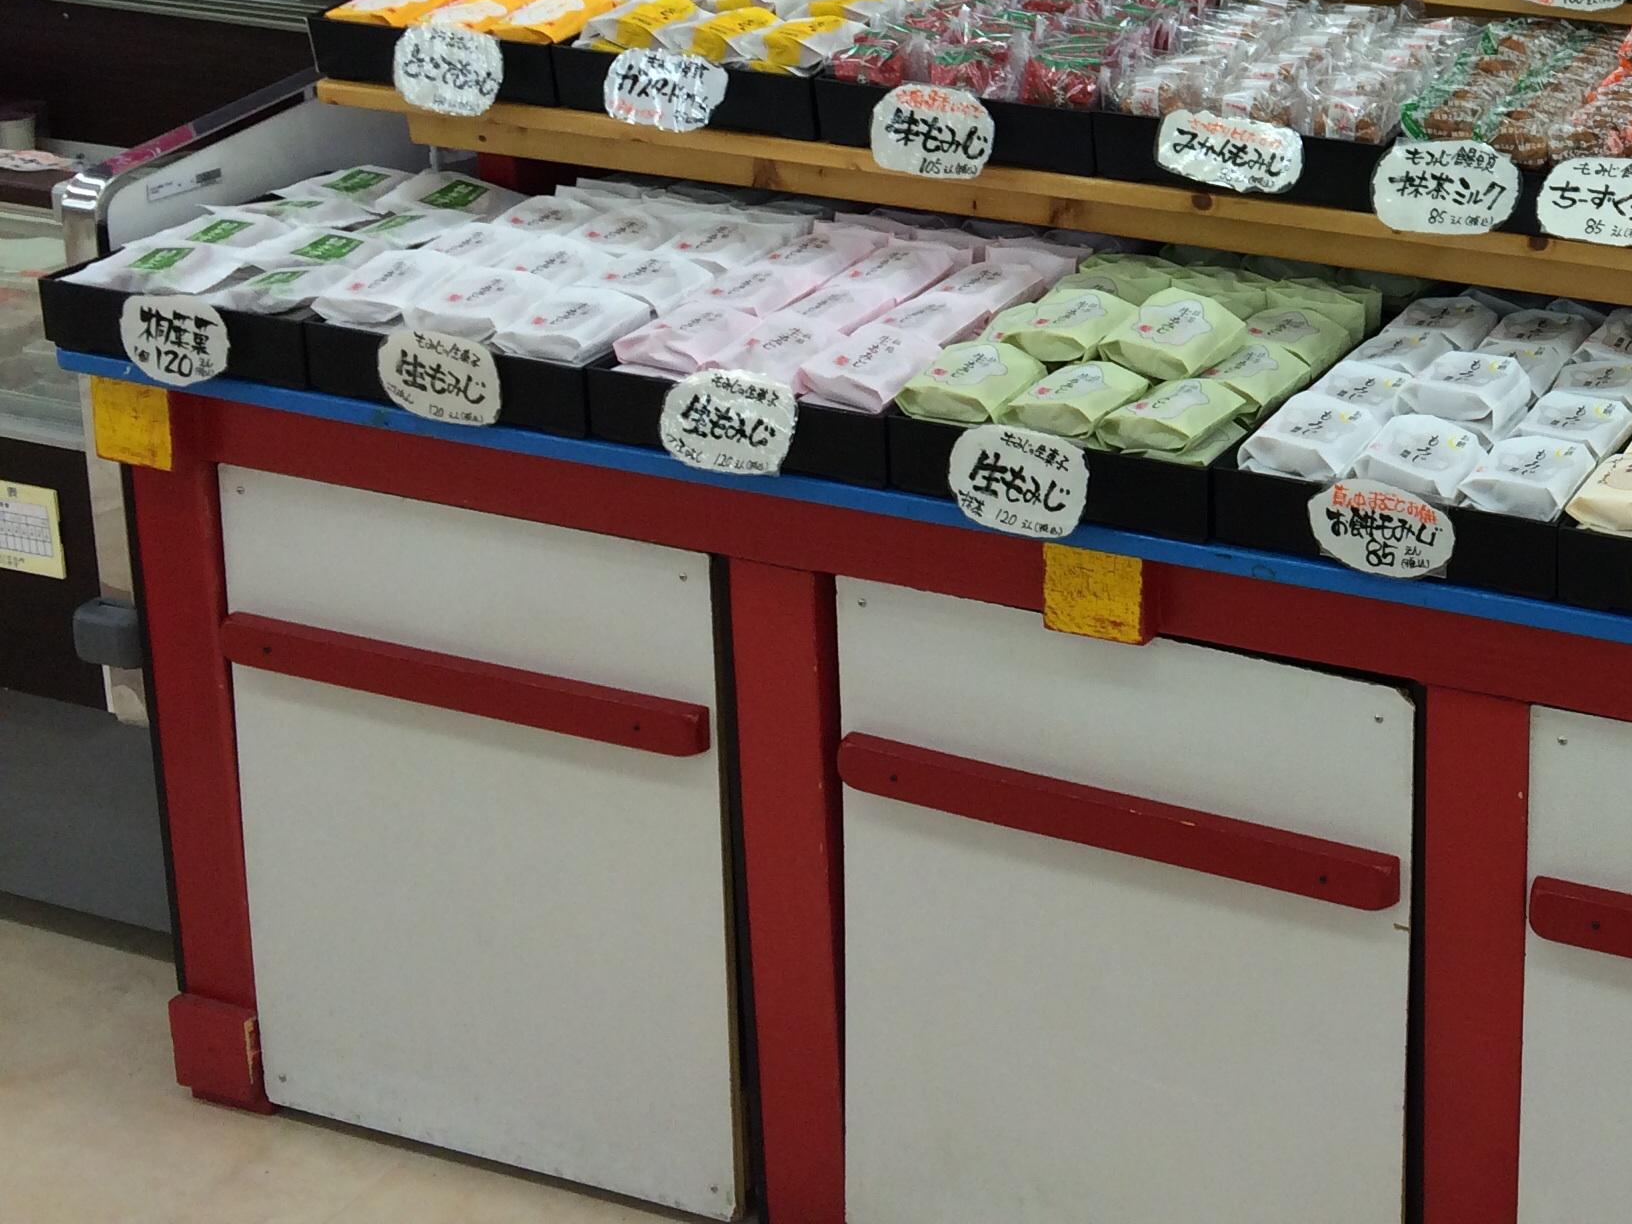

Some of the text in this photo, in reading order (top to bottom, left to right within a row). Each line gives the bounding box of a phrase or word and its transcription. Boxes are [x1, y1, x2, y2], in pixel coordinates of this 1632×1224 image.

[919, 158, 941, 174] 105
[1405, 147, 1499, 175] もみじ饅頭
[1387, 170, 1507, 211] 抹茶ミルク
[1427, 208, 1447, 225] 85
[1584, 218, 1605, 236] 85
[138, 305, 219, 355] 桐葉菓
[155, 348, 194, 378] 120
[396, 349, 486, 405] 生もみじ
[428, 403, 444, 418] 120
[680, 392, 777, 449] 生もみじ
[967, 449, 1071, 514] 生もみじ
[995, 509, 1018, 526] 120
[1325, 507, 1443, 547] お餅もみじ
[1365, 539, 1398, 567] 85
